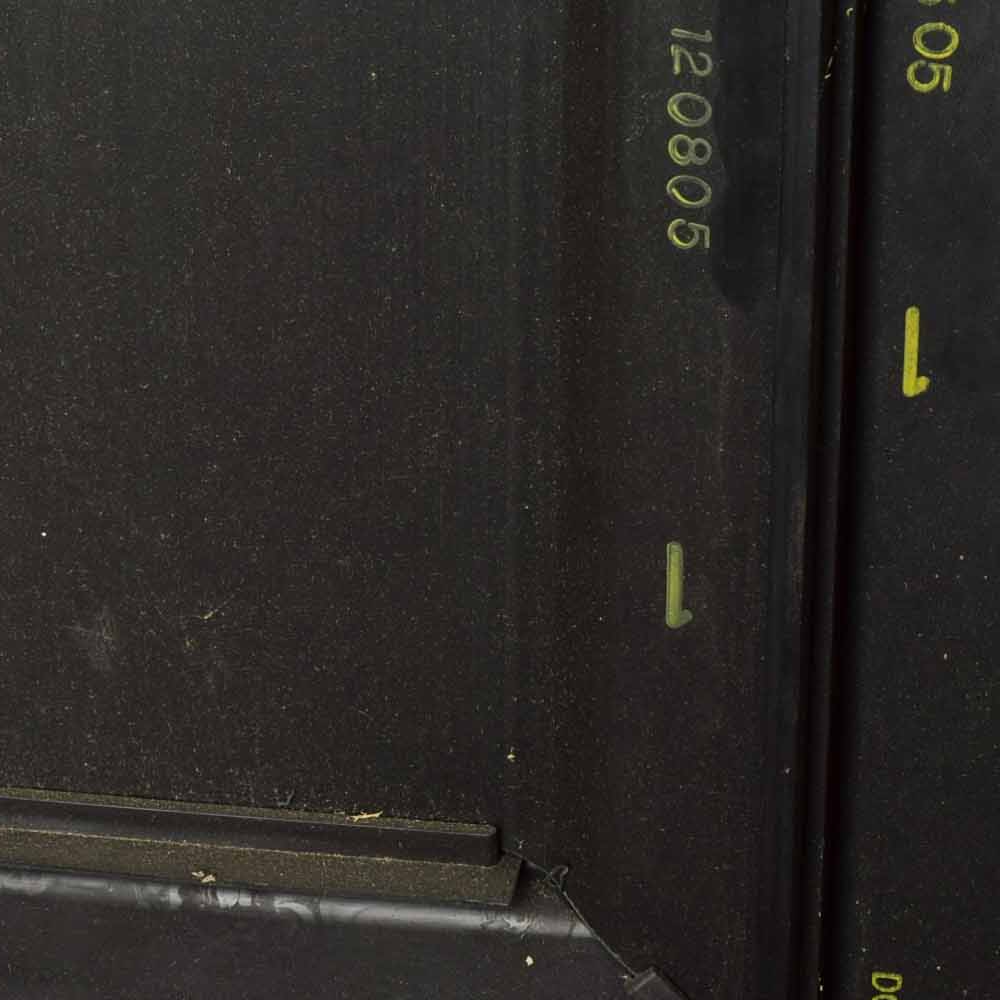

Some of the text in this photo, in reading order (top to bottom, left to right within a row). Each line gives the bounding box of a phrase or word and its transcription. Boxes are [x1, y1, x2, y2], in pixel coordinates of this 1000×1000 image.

[906, 0, 960, 93] 05
[666, 27, 713, 249] 120805
[902, 306, 931, 398] 1
[665, 541, 694, 629] 1
